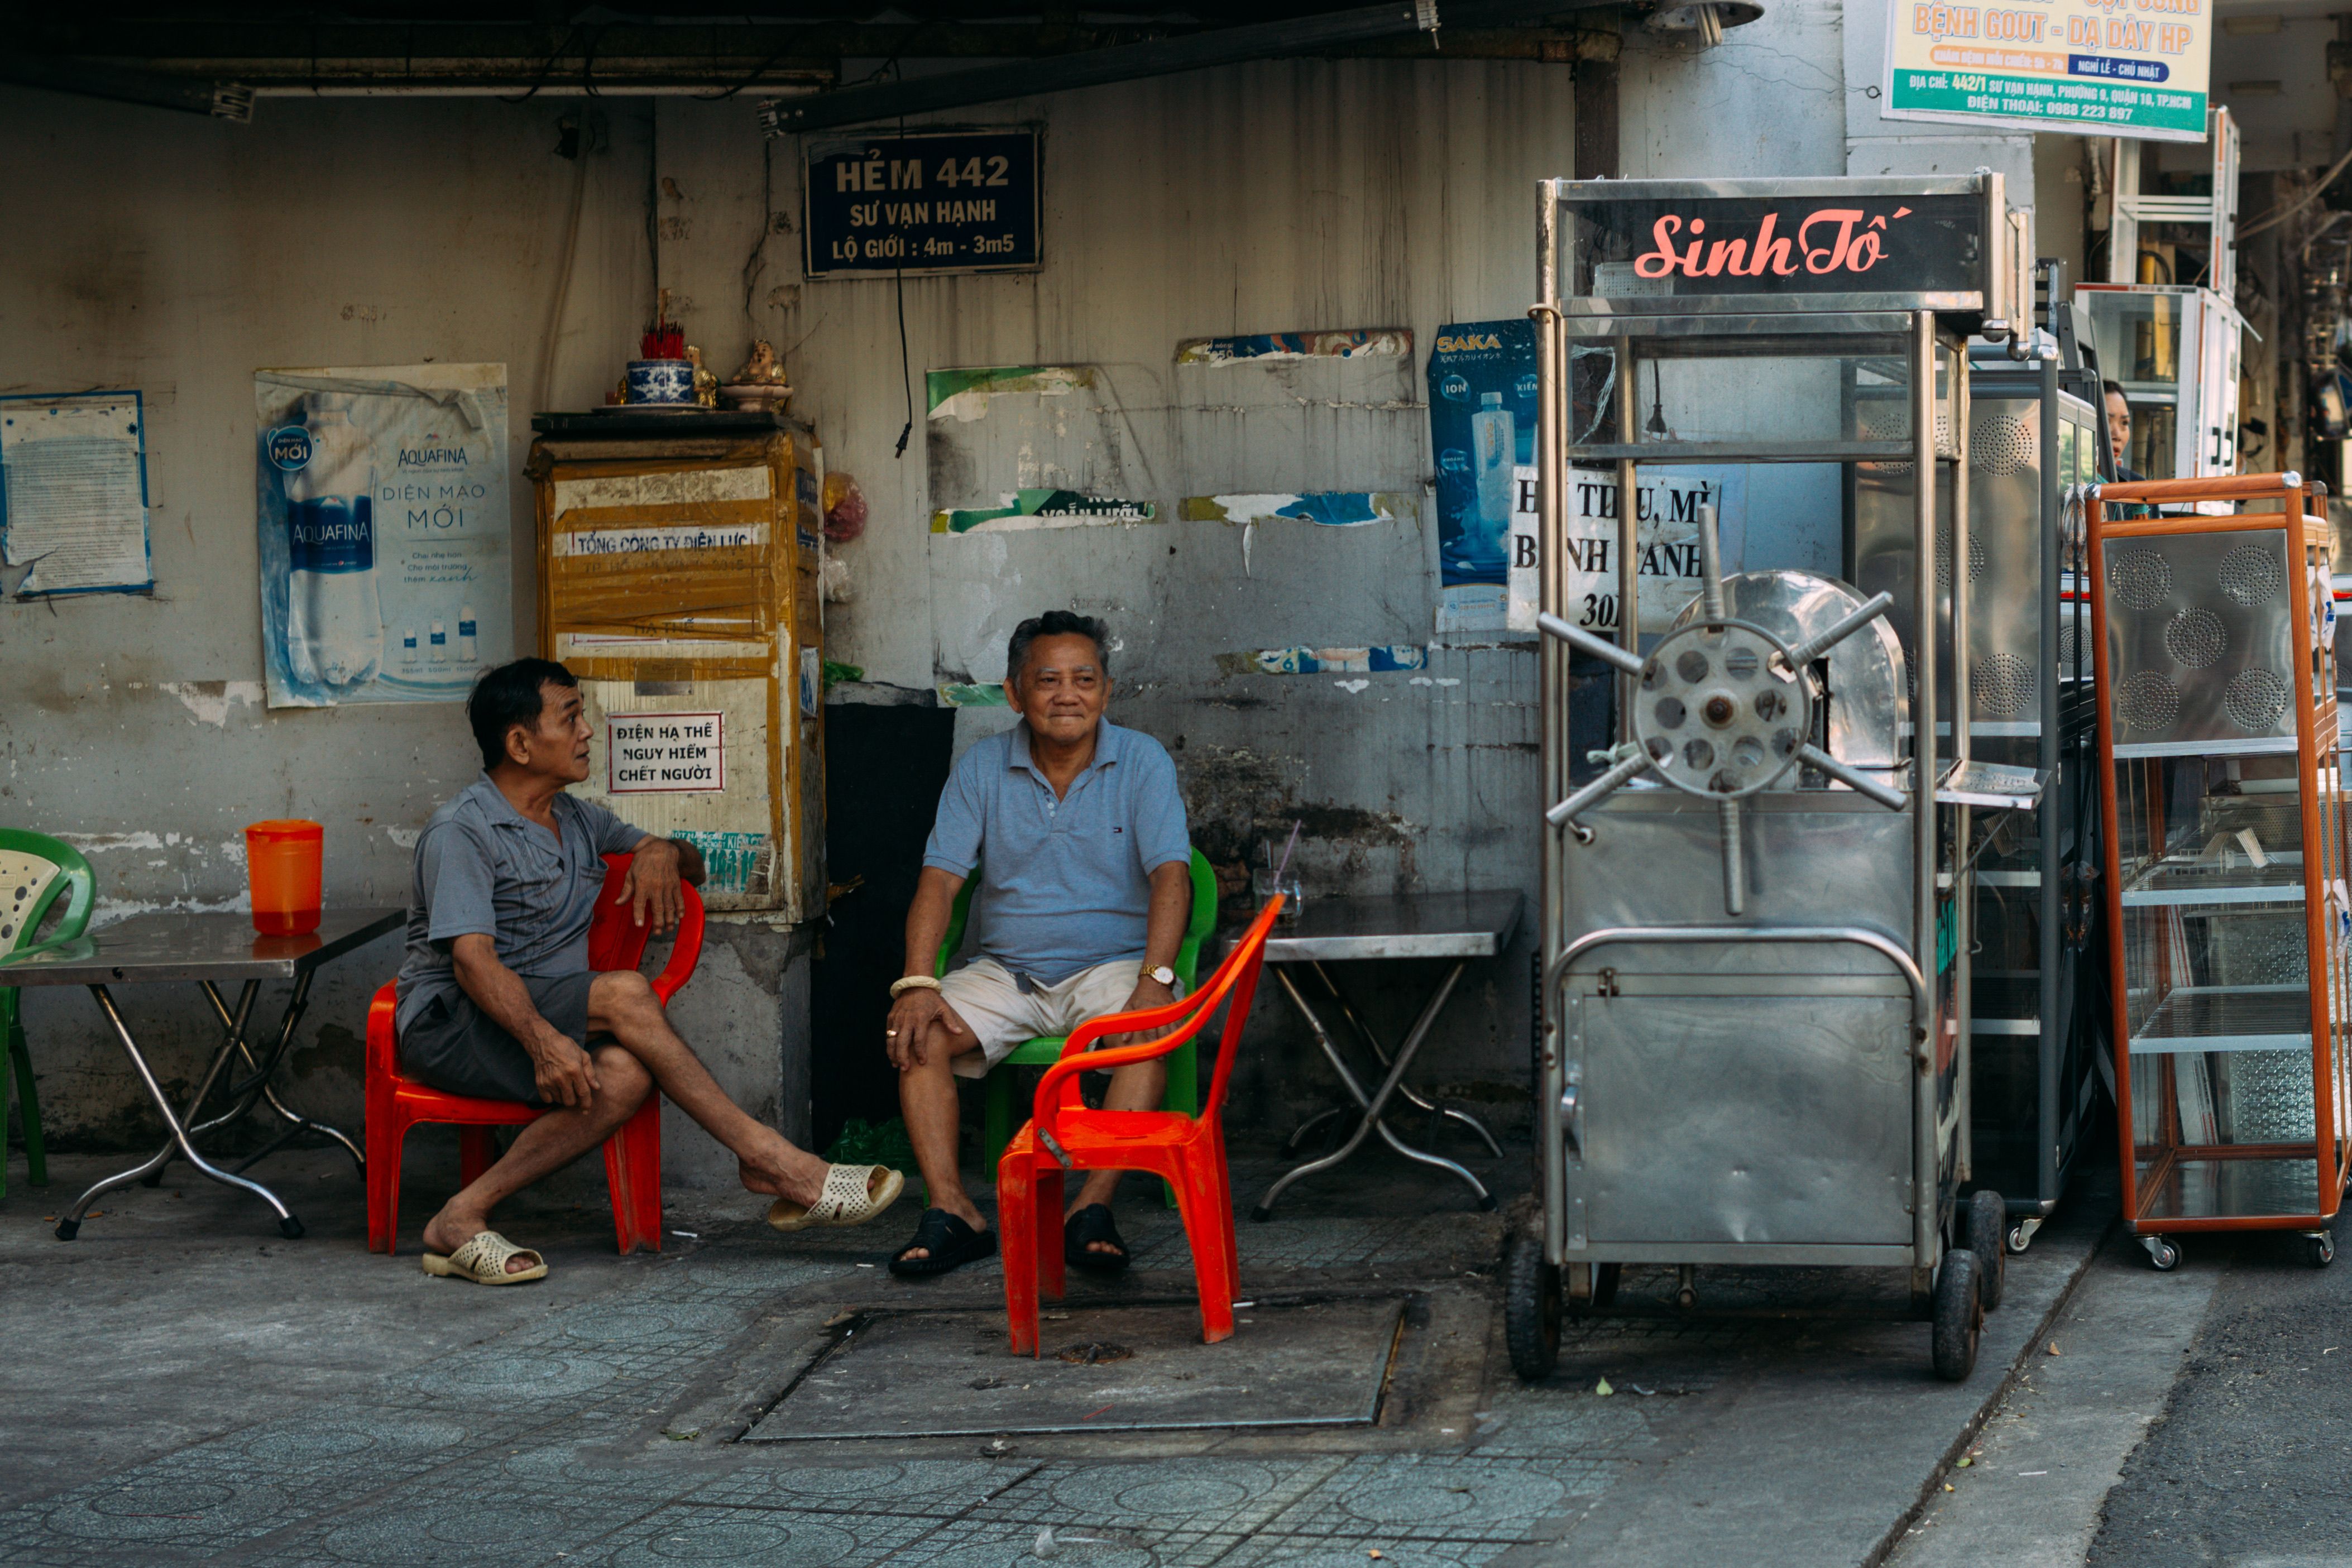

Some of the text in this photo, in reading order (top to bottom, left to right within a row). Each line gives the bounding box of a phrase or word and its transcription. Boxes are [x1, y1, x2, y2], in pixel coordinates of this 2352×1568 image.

[1914, 1, 1979, 41] BỆNH
[1985, 9, 2047, 42] GOUT
[2068, 16, 2101, 52] DẠ
[2107, 15, 2154, 51] DÀY
[2159, 22, 2193, 55] HP
[1909, 74, 1926, 90] ĐỊA
[1952, 74, 1986, 91] 442/1
[2137, 64, 2160, 80] NHẬT
[1967, 94, 2133, 120] ĐIỆN THOẠI: 0988 223 897
[837, 148, 1009, 191] HẺM 442
[850, 199, 995, 229] SƯ VẠN HẠNH
[832, 235, 858, 262] LỘ
[865, 234, 904, 258] GIỚI
[924, 237, 953, 257] 4m
[973, 234, 1014, 254] 3m5
[1634, 206, 1913, 278] Sinh Tố
[1437, 334, 1502, 353] SAKA
[1445, 384, 1467, 394] ION
[275, 443, 308, 460] MỚI
[398, 447, 467, 467] AQUAFINA
[383, 484, 485, 502] DIỆN MẠO
[408, 504, 462, 528] MỚI
[293, 521, 370, 545] AQUAFINA
[578, 530, 616, 554] TỔNG
[620, 532, 659, 553] CÔNG
[1513, 535, 1702, 577] BNH ANH
[617, 722, 712, 742] ĐIỆN HẠ THẾ
[624, 744, 706, 760] NGUY HIỂM
[619, 764, 711, 781] CHẾT NGƯỜI
